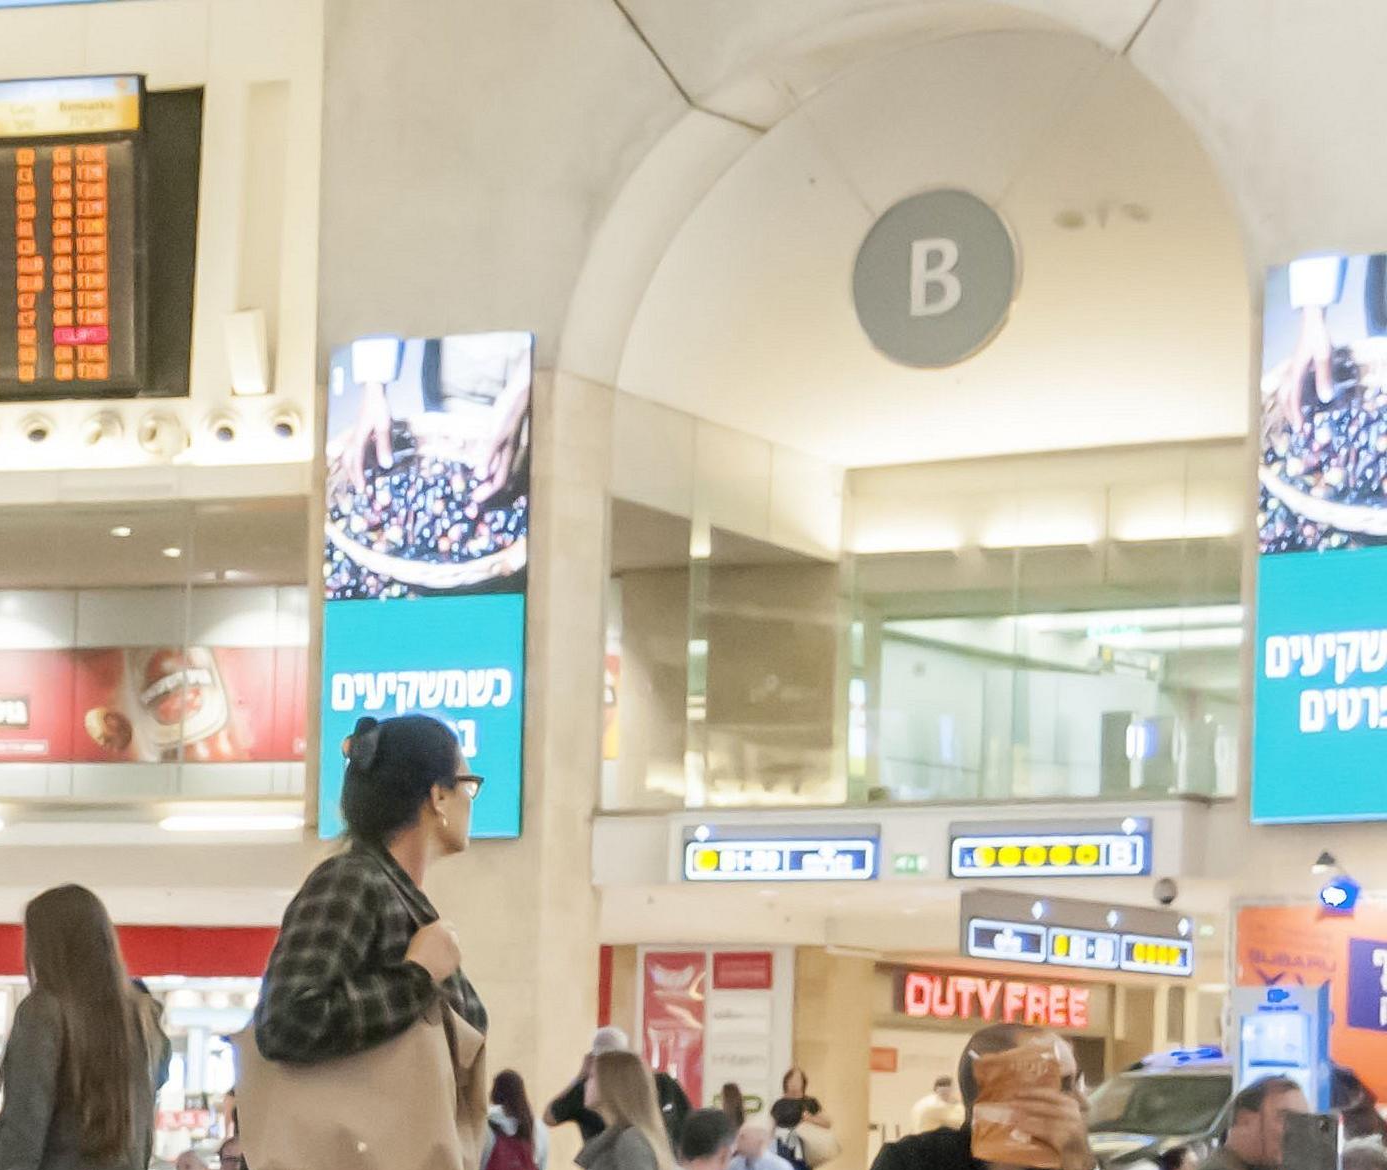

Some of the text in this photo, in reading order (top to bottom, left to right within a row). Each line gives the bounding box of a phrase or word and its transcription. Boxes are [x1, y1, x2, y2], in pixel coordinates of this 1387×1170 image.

[910, 237, 963, 317] B
[1265, 630, 1387, 684] שקיעים
[330, 668, 512, 714] כשמשקיעים
[1299, 685, 1387, 734] רטים
[905, 971, 1090, 1029] DUTY FREE
